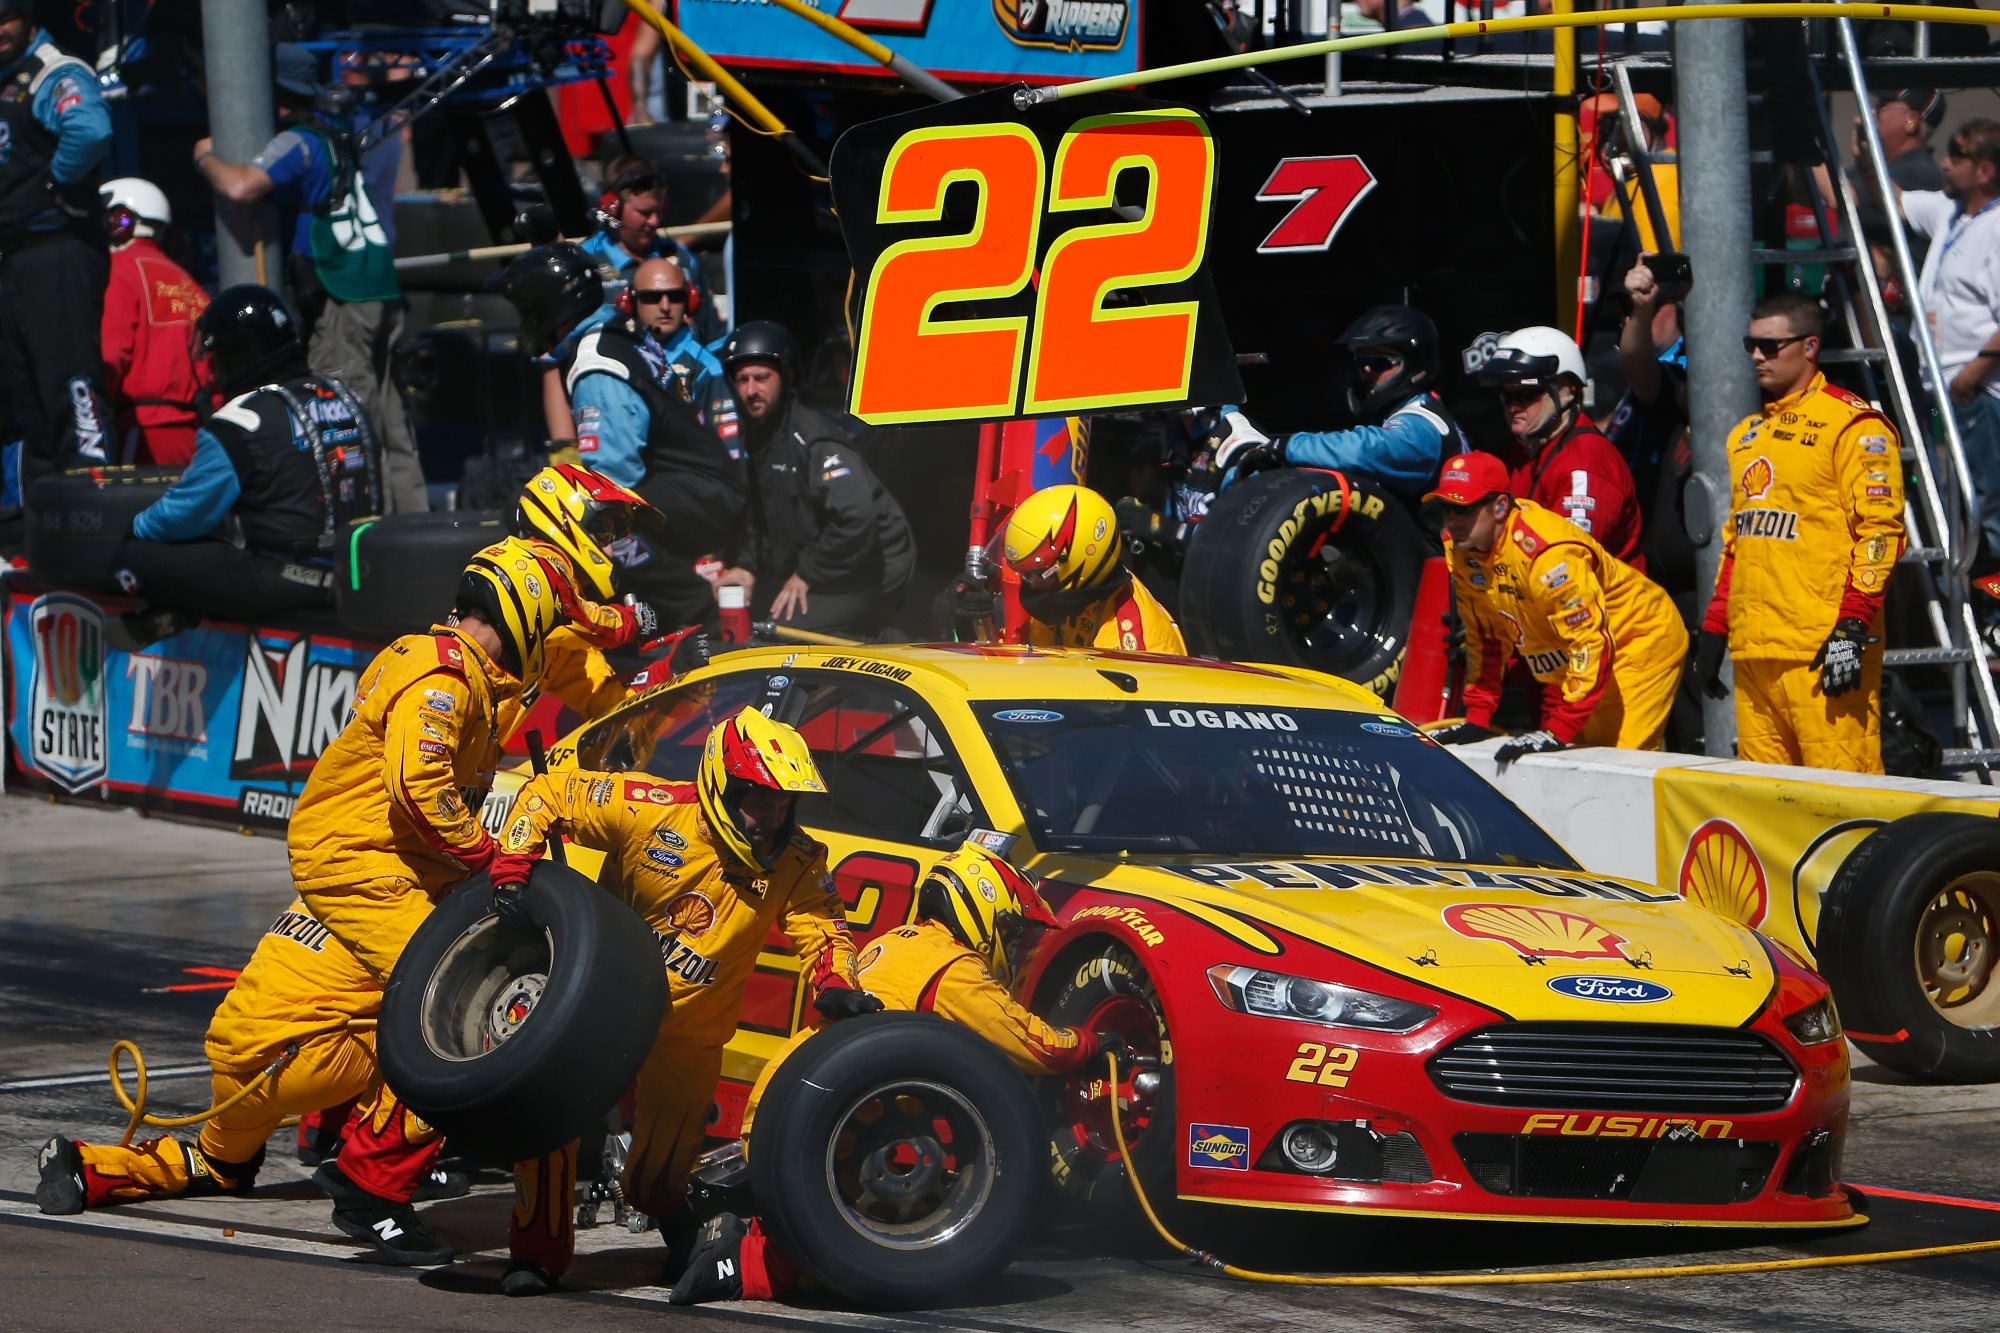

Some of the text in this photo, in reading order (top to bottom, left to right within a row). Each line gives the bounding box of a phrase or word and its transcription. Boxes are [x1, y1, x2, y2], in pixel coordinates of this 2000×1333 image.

[1045, 0, 1125, 36] RIPPERS
[1256, 155, 1377, 253] 7
[851, 108, 1214, 425] 22
[37, 611, 100, 705] TOY
[821, 656, 912, 683] JOEY LOGANO
[127, 653, 207, 743] TBR
[1008, 710, 1050, 721] Ford
[1145, 708, 1298, 731] LOGANO
[41, 709, 99, 761] STATE
[546, 747, 576, 766] KF
[243, 790, 297, 819] RADI
[513, 819, 526, 846] PENNZOIL
[653, 850, 678, 864] Ford
[1158, 861, 1687, 904] PENNZOIL
[1072, 906, 1165, 947] GOODYEAR
[1575, 977, 1648, 998] Ford
[1285, 1042, 1359, 1088] 22
[1193, 1141, 1246, 1156] SUNOCO
[372, 1217, 403, 1241] N
[716, 1258, 735, 1280] N
